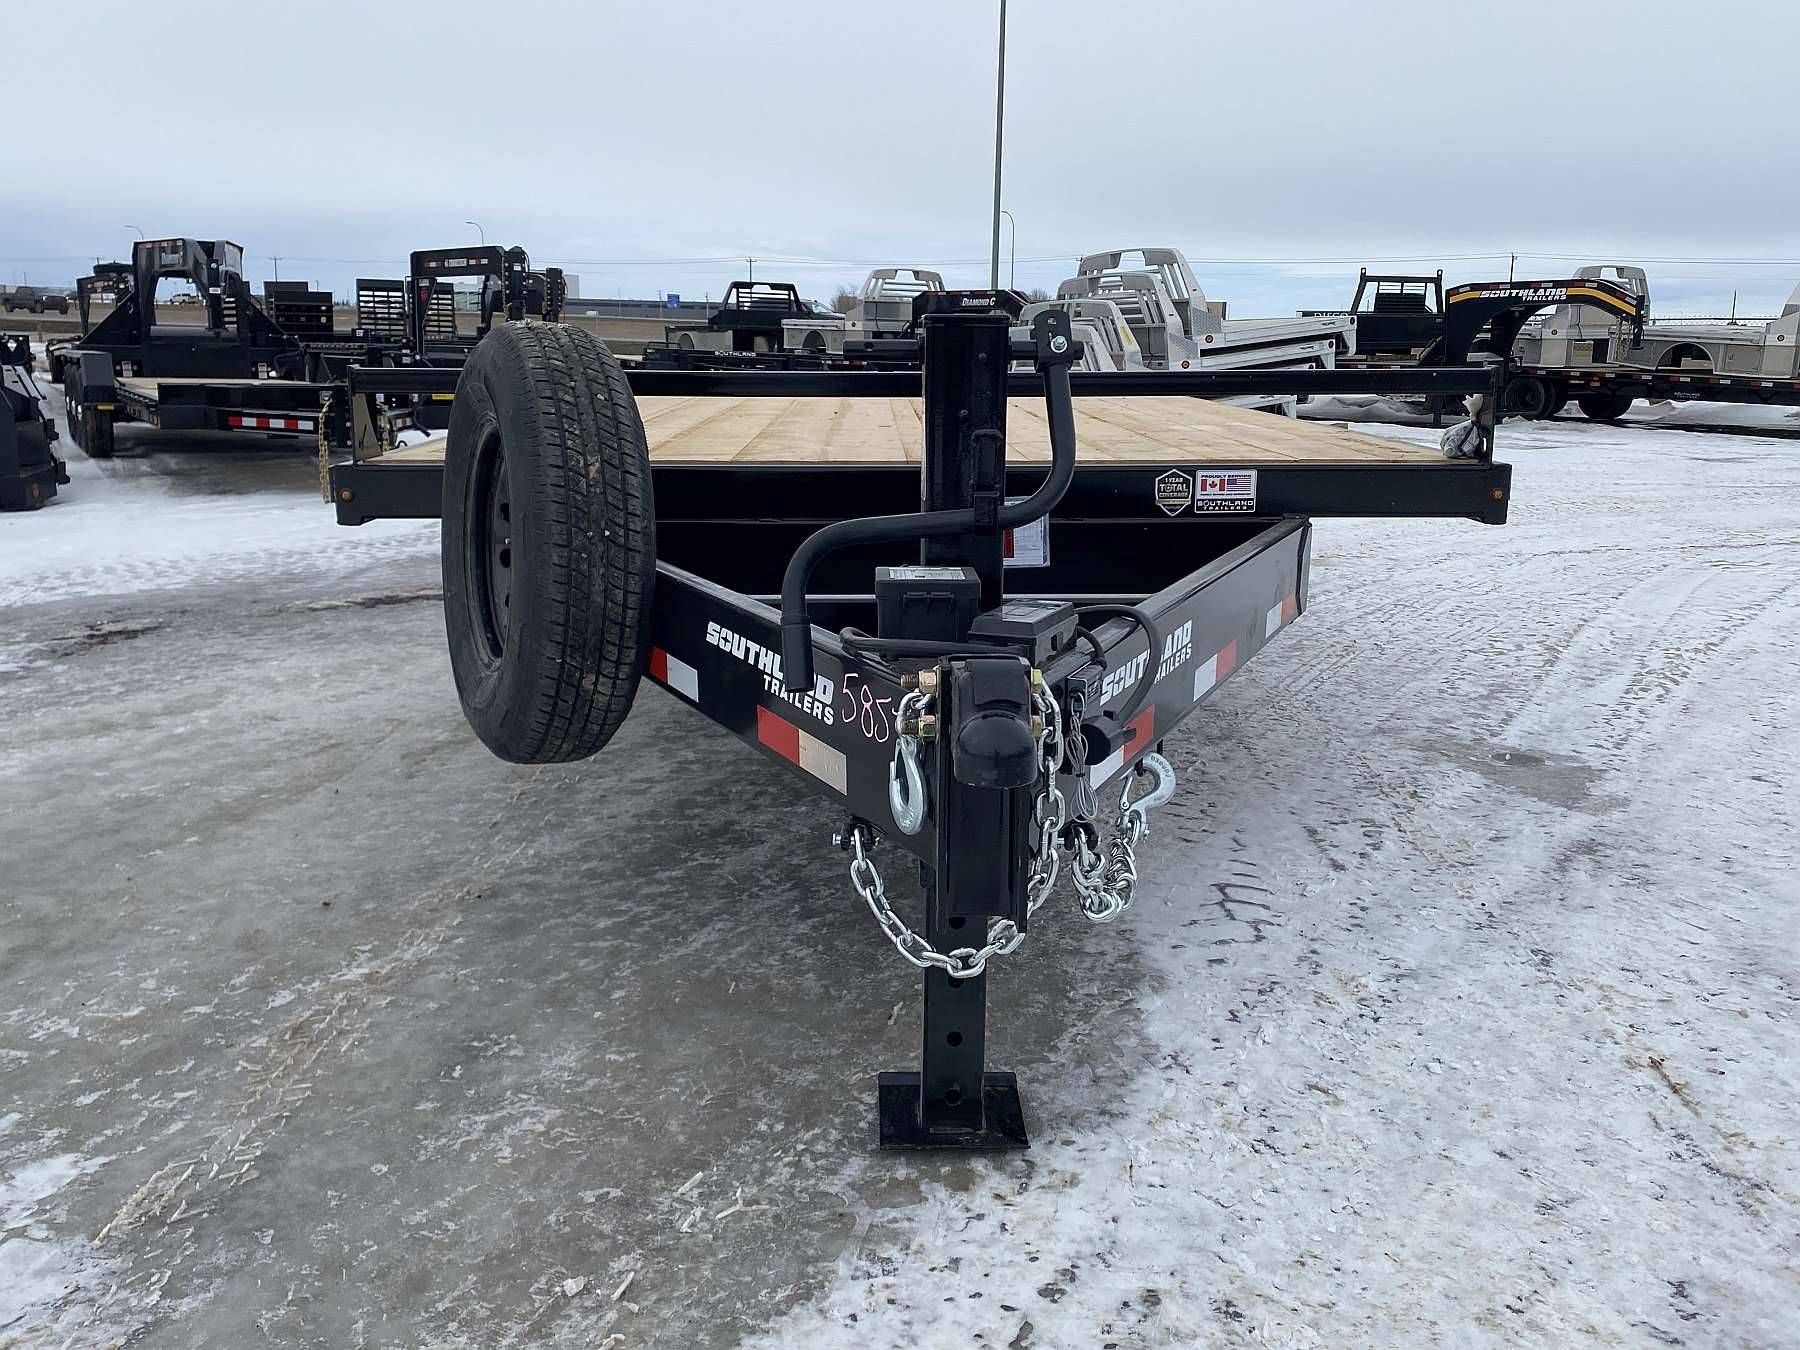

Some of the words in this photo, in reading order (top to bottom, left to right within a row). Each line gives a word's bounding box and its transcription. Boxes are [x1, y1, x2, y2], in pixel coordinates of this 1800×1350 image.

[962, 298, 989, 306] DIAMOND
[989, 297, 996, 306] C
[1479, 288, 1566, 298] SOUTHLAND
[1159, 484, 1188, 492] TOTAL
[705, 620, 835, 706] SOUTHLD
[1100, 619, 1193, 706] SOUTAND
[763, 674, 835, 726] TRAILERS
